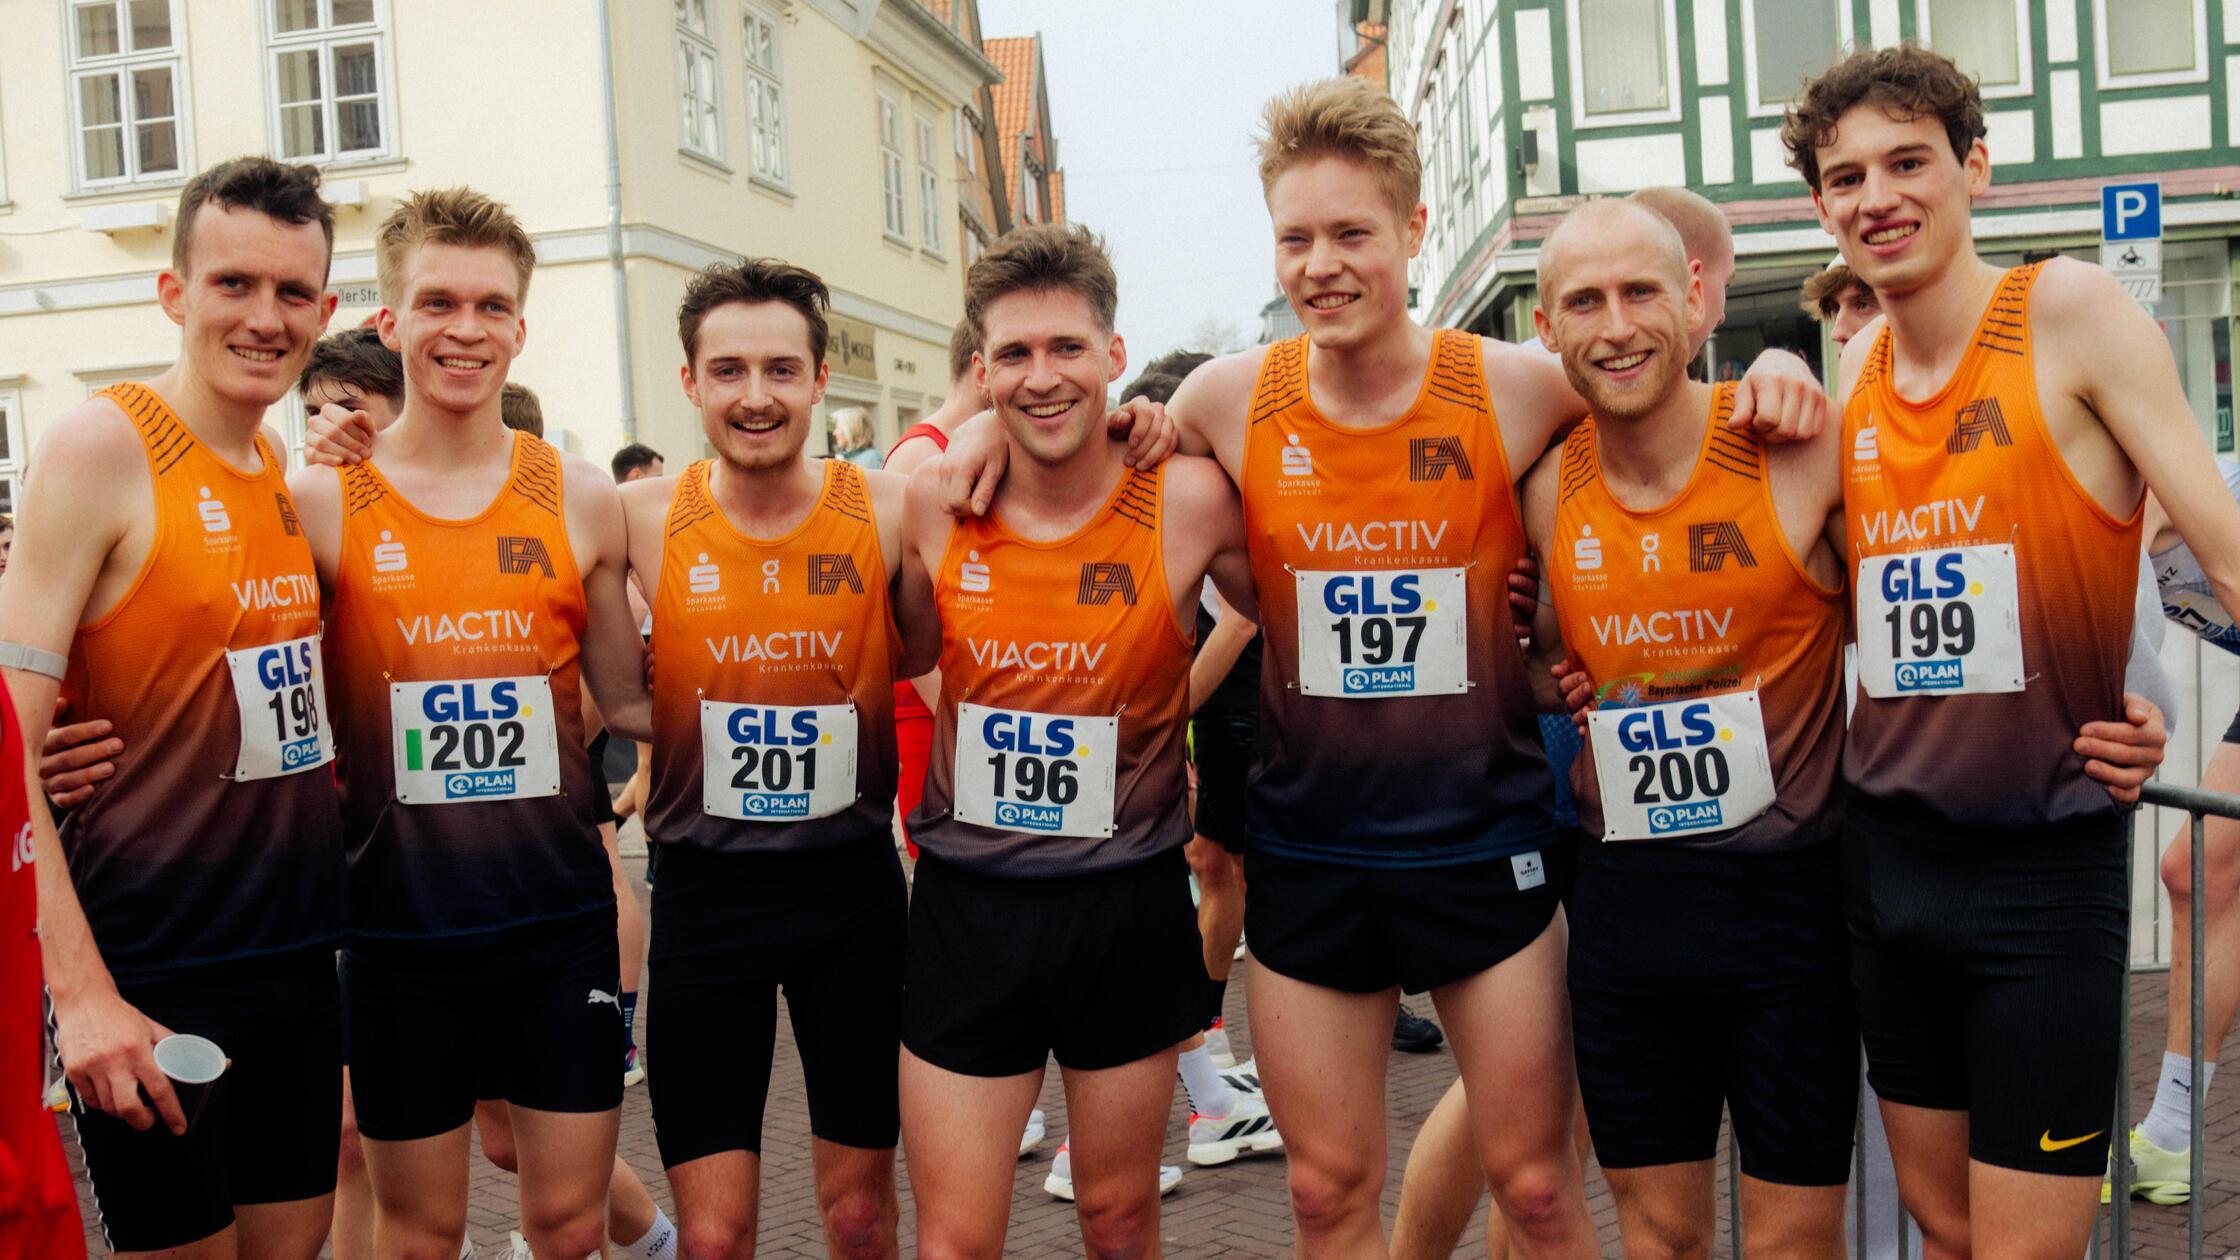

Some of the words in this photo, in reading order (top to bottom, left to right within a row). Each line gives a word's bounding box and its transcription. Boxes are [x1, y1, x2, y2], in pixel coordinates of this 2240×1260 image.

[2116, 190, 2147, 234] P
[1278, 479, 1321, 489] Sparkasse
[1861, 495, 1985, 545] VIACTIV
[1296, 520, 1448, 552] VIACTIV
[1354, 555, 1449, 565] Krankenkasse
[372, 574, 415, 584] Sparkasse
[1572, 573, 1608, 583] Sparkasse
[686, 596, 726, 606] Sparkasse
[957, 593, 994, 603] Sparkasse
[396, 610, 534, 646] VIACTIV
[1590, 607, 1733, 646] VIACTIV
[1885, 601, 1975, 658] 199
[453, 643, 539, 654] Krankenkasse
[706, 631, 842, 664] VIACTIV
[1331, 616, 1427, 665] 197
[967, 637, 1107, 671] VIACTIV
[1643, 643, 1738, 657] Krankenkasse
[759, 663, 843, 673] Krankenkasse
[1371, 670, 1412, 683] PLAN
[1919, 664, 1959, 679] PLAN
[1015, 673, 1103, 685] Krankenkasse
[1648, 682, 1702, 698] Bayerische
[1706, 677, 1742, 691] Polizei
[269, 684, 318, 742] 198
[429, 721, 526, 771] 202
[731, 746, 816, 791] 201
[1629, 747, 1730, 804] 200
[475, 774, 513, 788] PLAN
[988, 752, 1079, 805] 196
[771, 797, 807, 808] PLAN
[1022, 808, 1060, 822] PLAN
[1677, 804, 1718, 821] PLAN
